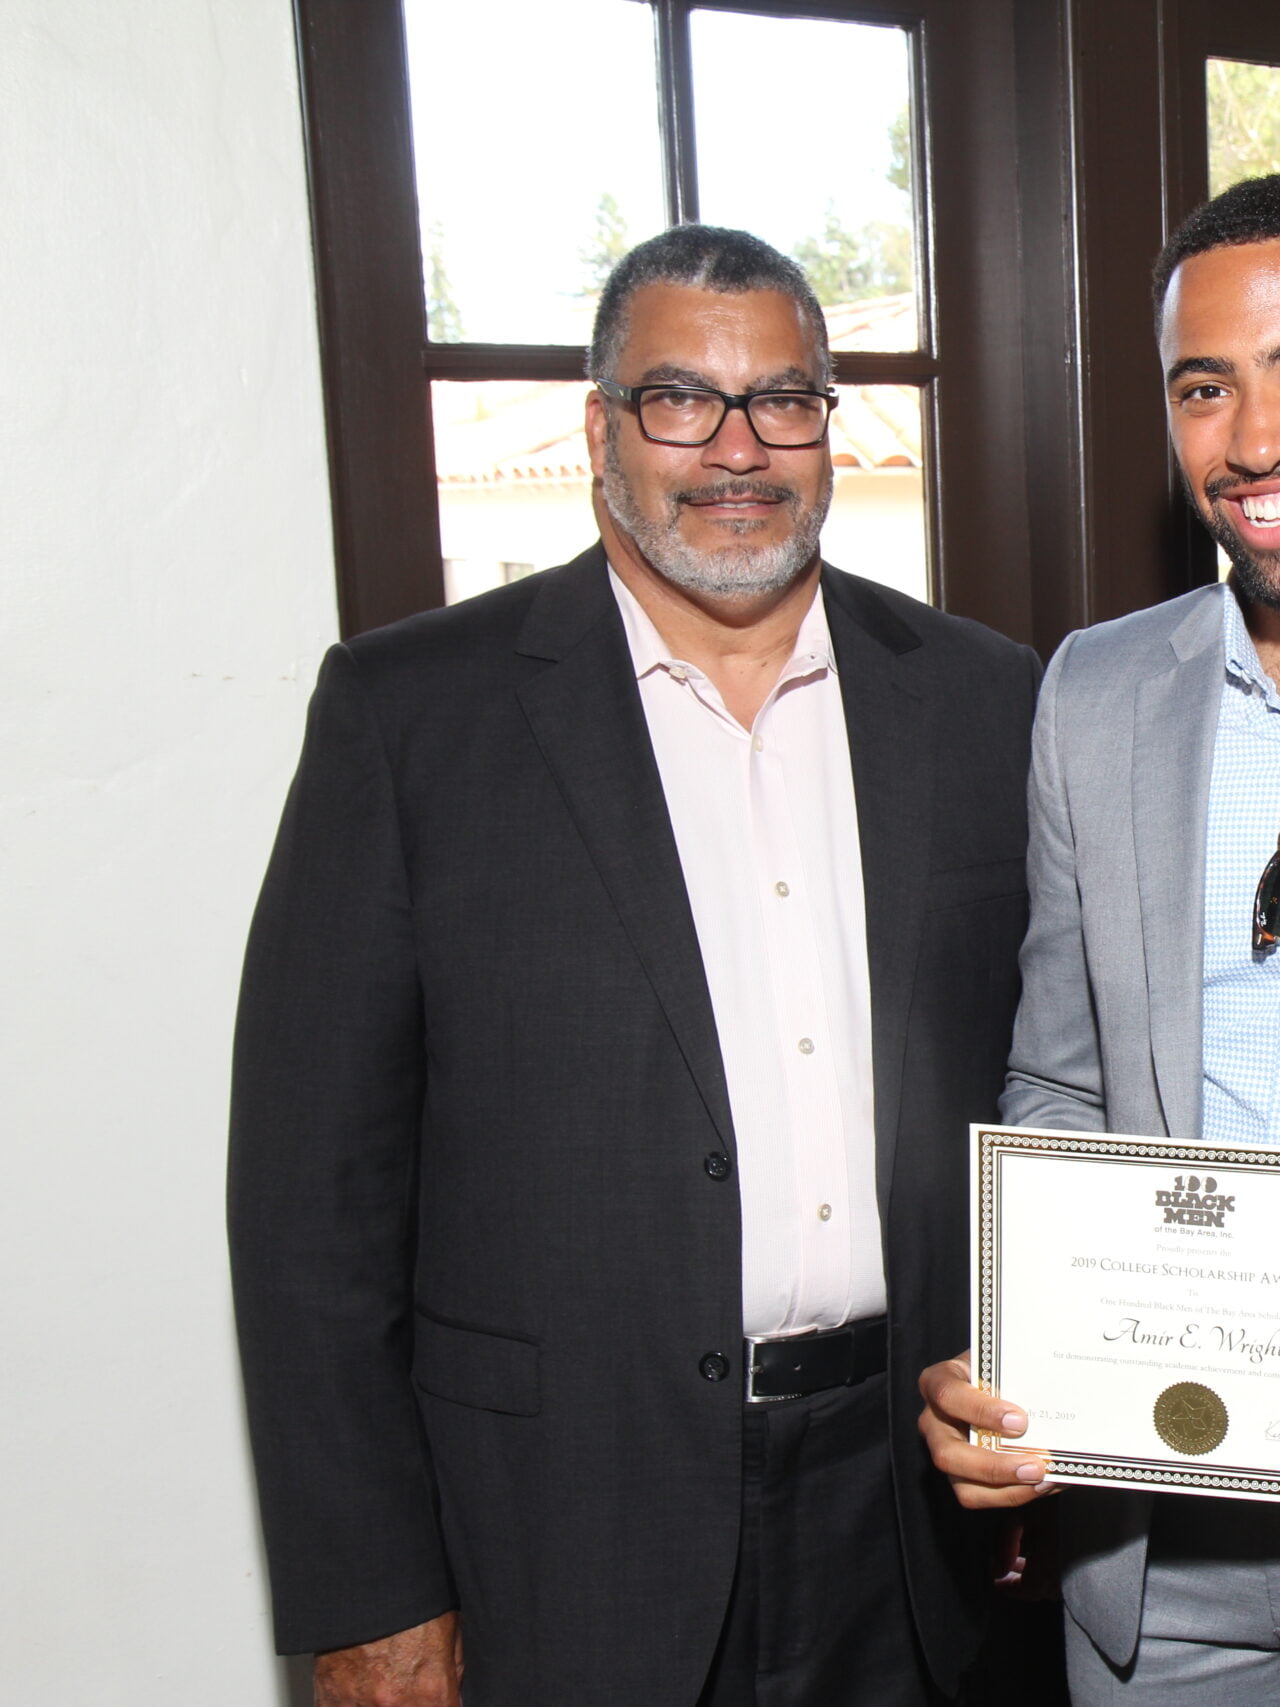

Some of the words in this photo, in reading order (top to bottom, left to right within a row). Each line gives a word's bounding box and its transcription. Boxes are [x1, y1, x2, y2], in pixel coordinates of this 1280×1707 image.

[1174, 1175, 1218, 1193] 100
[1155, 1190, 1236, 1212] BLACK
[1163, 1207, 1225, 1228] MEN
[1164, 1226, 1177, 1234] the
[1179, 1227, 1195, 1237] Bay
[1197, 1229, 1218, 1238] Area,
[1071, 1256, 1097, 1268] 2019
[1100, 1257, 1159, 1275] COLLEGE
[1161, 1263, 1256, 1282] SCHOLARSHIP
[1100, 1297, 1117, 1306] One
[1118, 1298, 1152, 1309] Hundred
[1153, 1301, 1175, 1311] Black
[1102, 1317, 1174, 1346] Amir
[1179, 1323, 1202, 1350] E.
[1039, 1409, 1053, 1420] 21,
[1055, 1411, 1076, 1421] 2019
